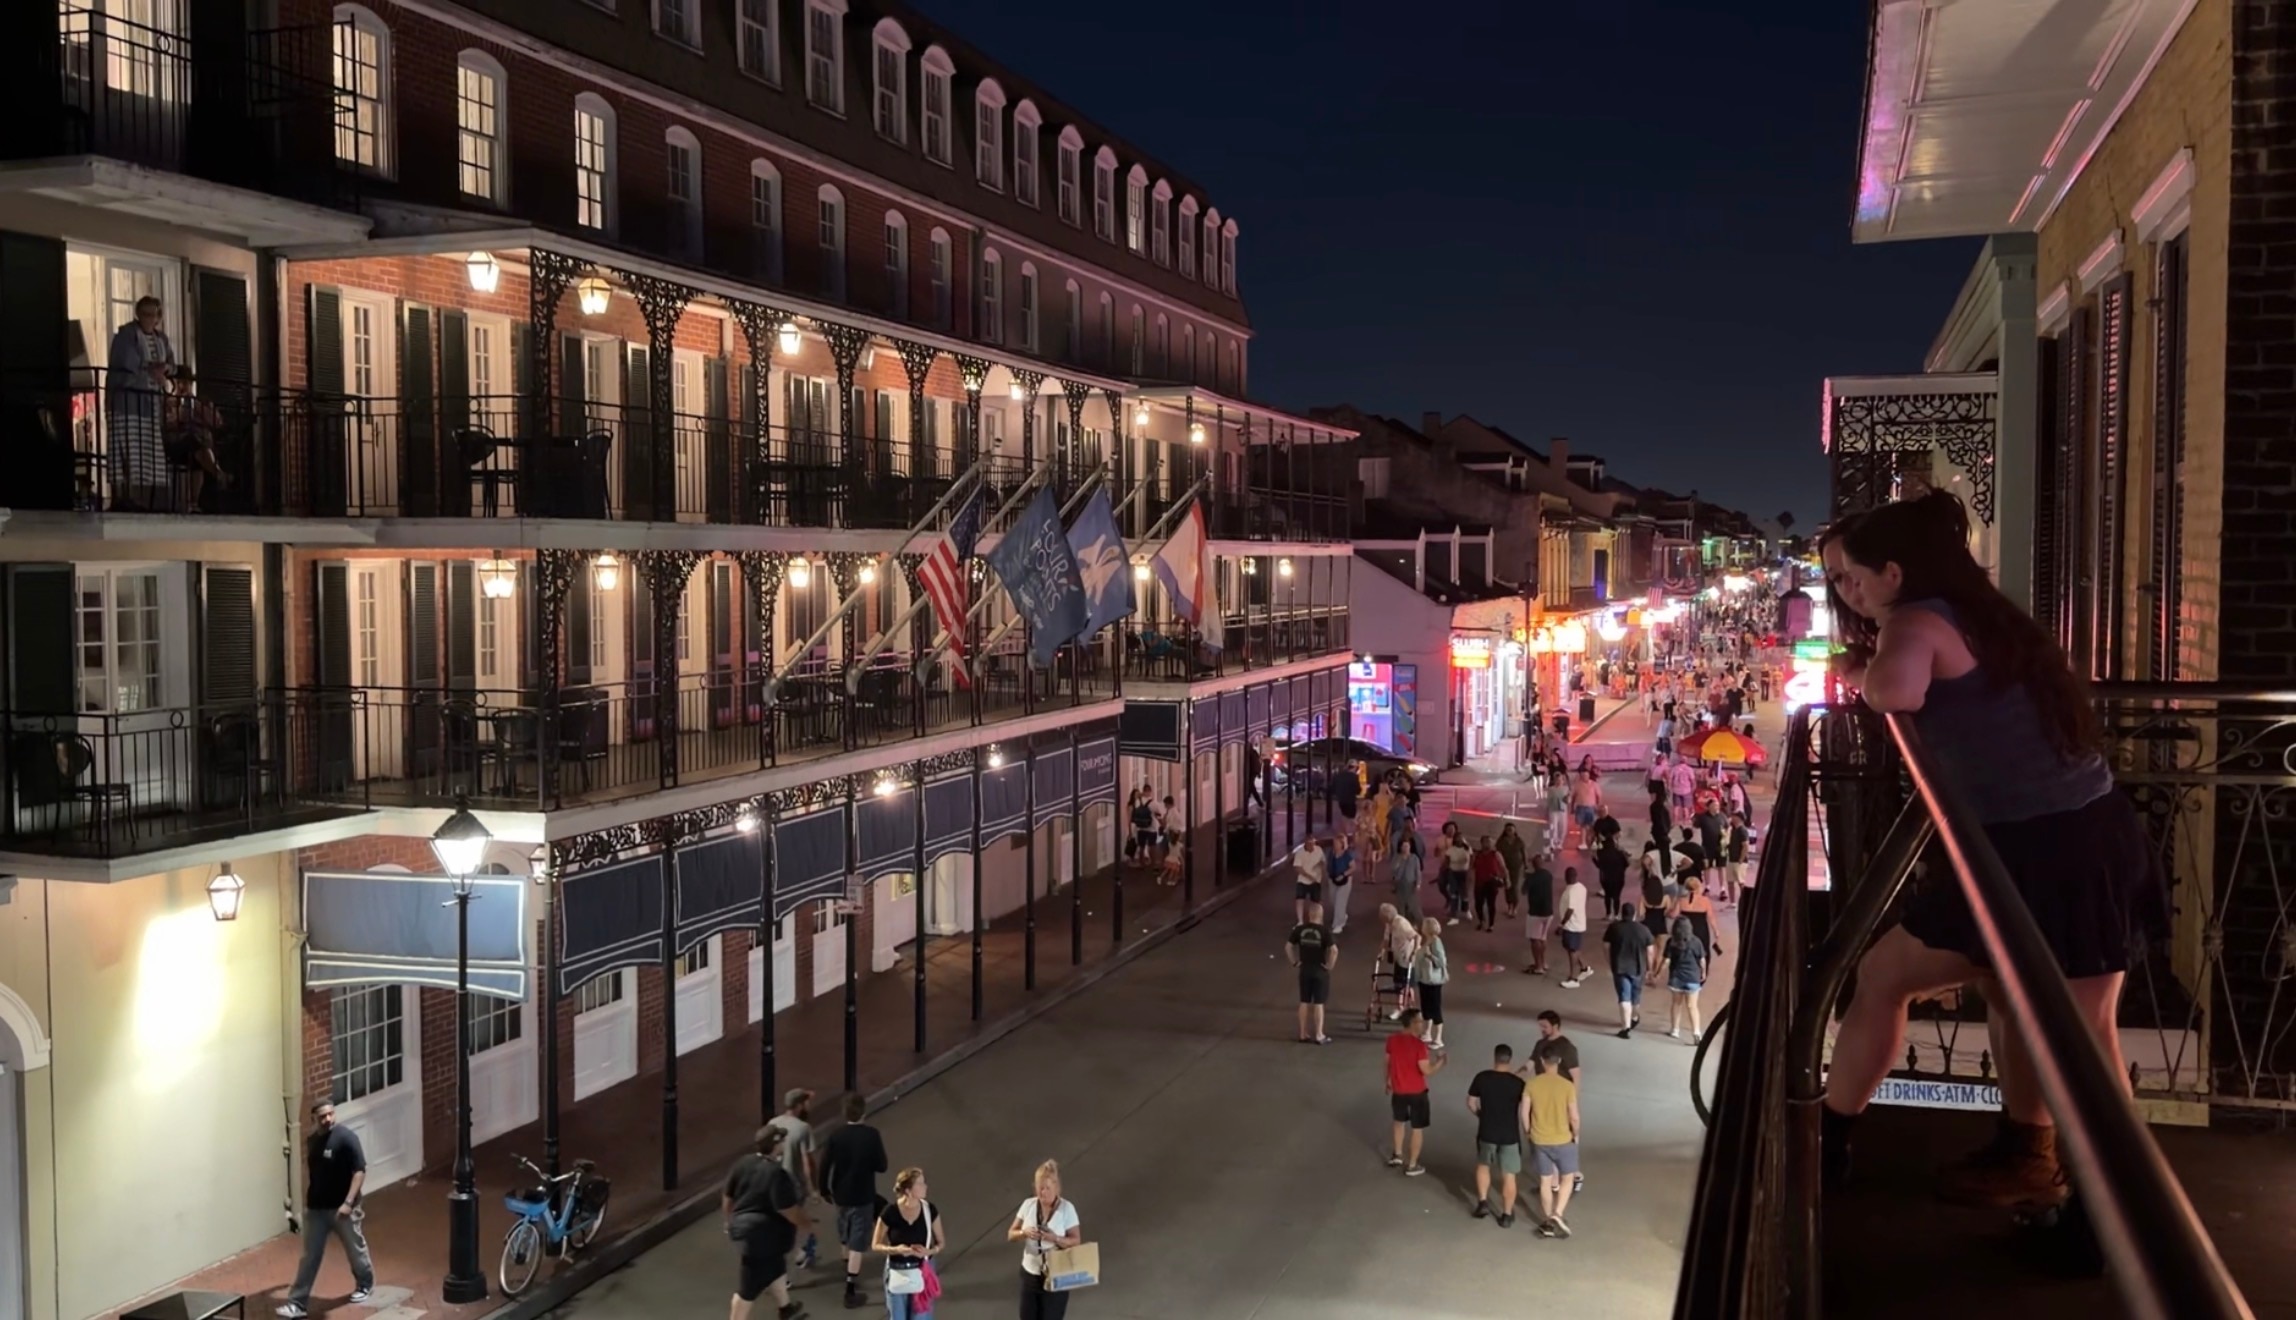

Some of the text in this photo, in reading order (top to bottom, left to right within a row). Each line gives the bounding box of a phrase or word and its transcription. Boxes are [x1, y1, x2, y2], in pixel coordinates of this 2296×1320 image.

[1030, 538, 1061, 612] POTS
[1872, 1082, 1890, 1100] FT
[1893, 1082, 1941, 1101] DRINKS
[1944, 1084, 1975, 1104] ATM
